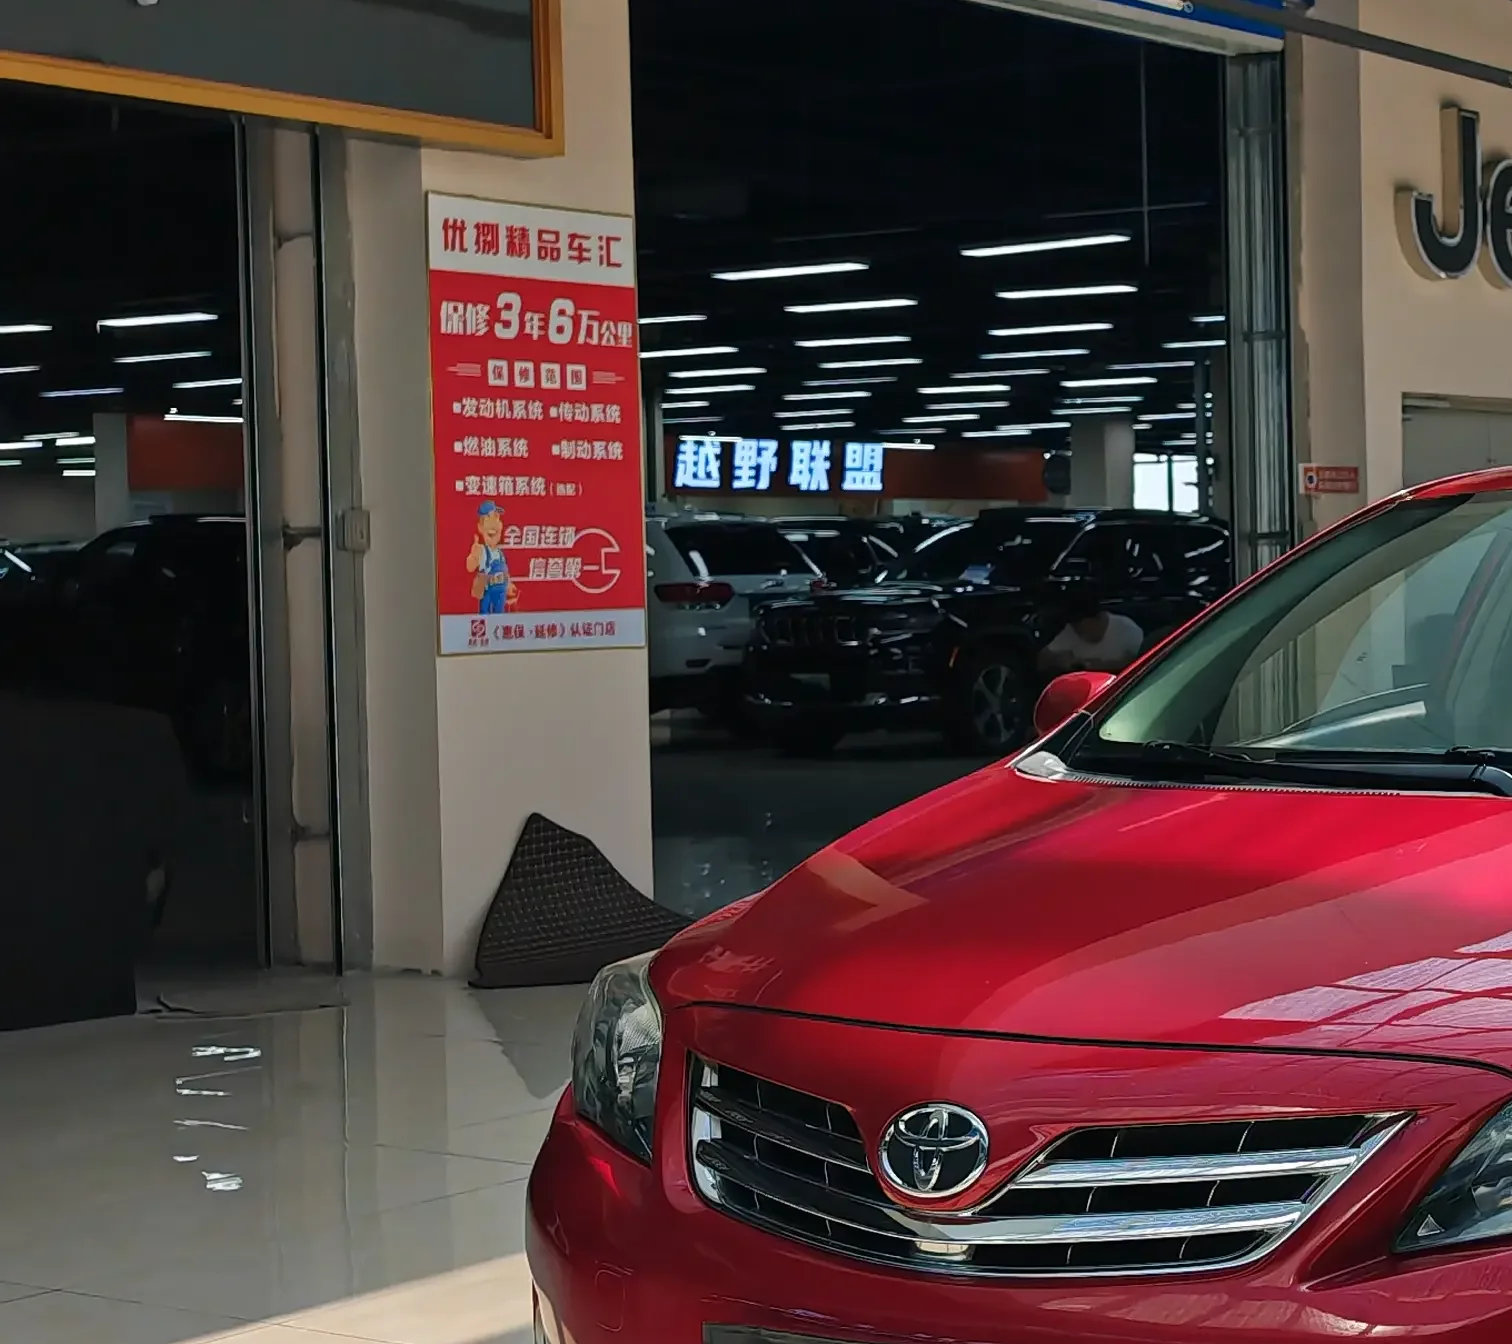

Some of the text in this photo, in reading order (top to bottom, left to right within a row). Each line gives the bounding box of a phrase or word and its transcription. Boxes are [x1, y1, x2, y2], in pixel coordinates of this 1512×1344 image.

[439, 291, 633, 348] 保修3年6万公里
[461, 396, 622, 424] 发动机系统 传动系统
[462, 435, 624, 461] 燃油系统 制动系统
[674, 438, 884, 492] 越野联盟
